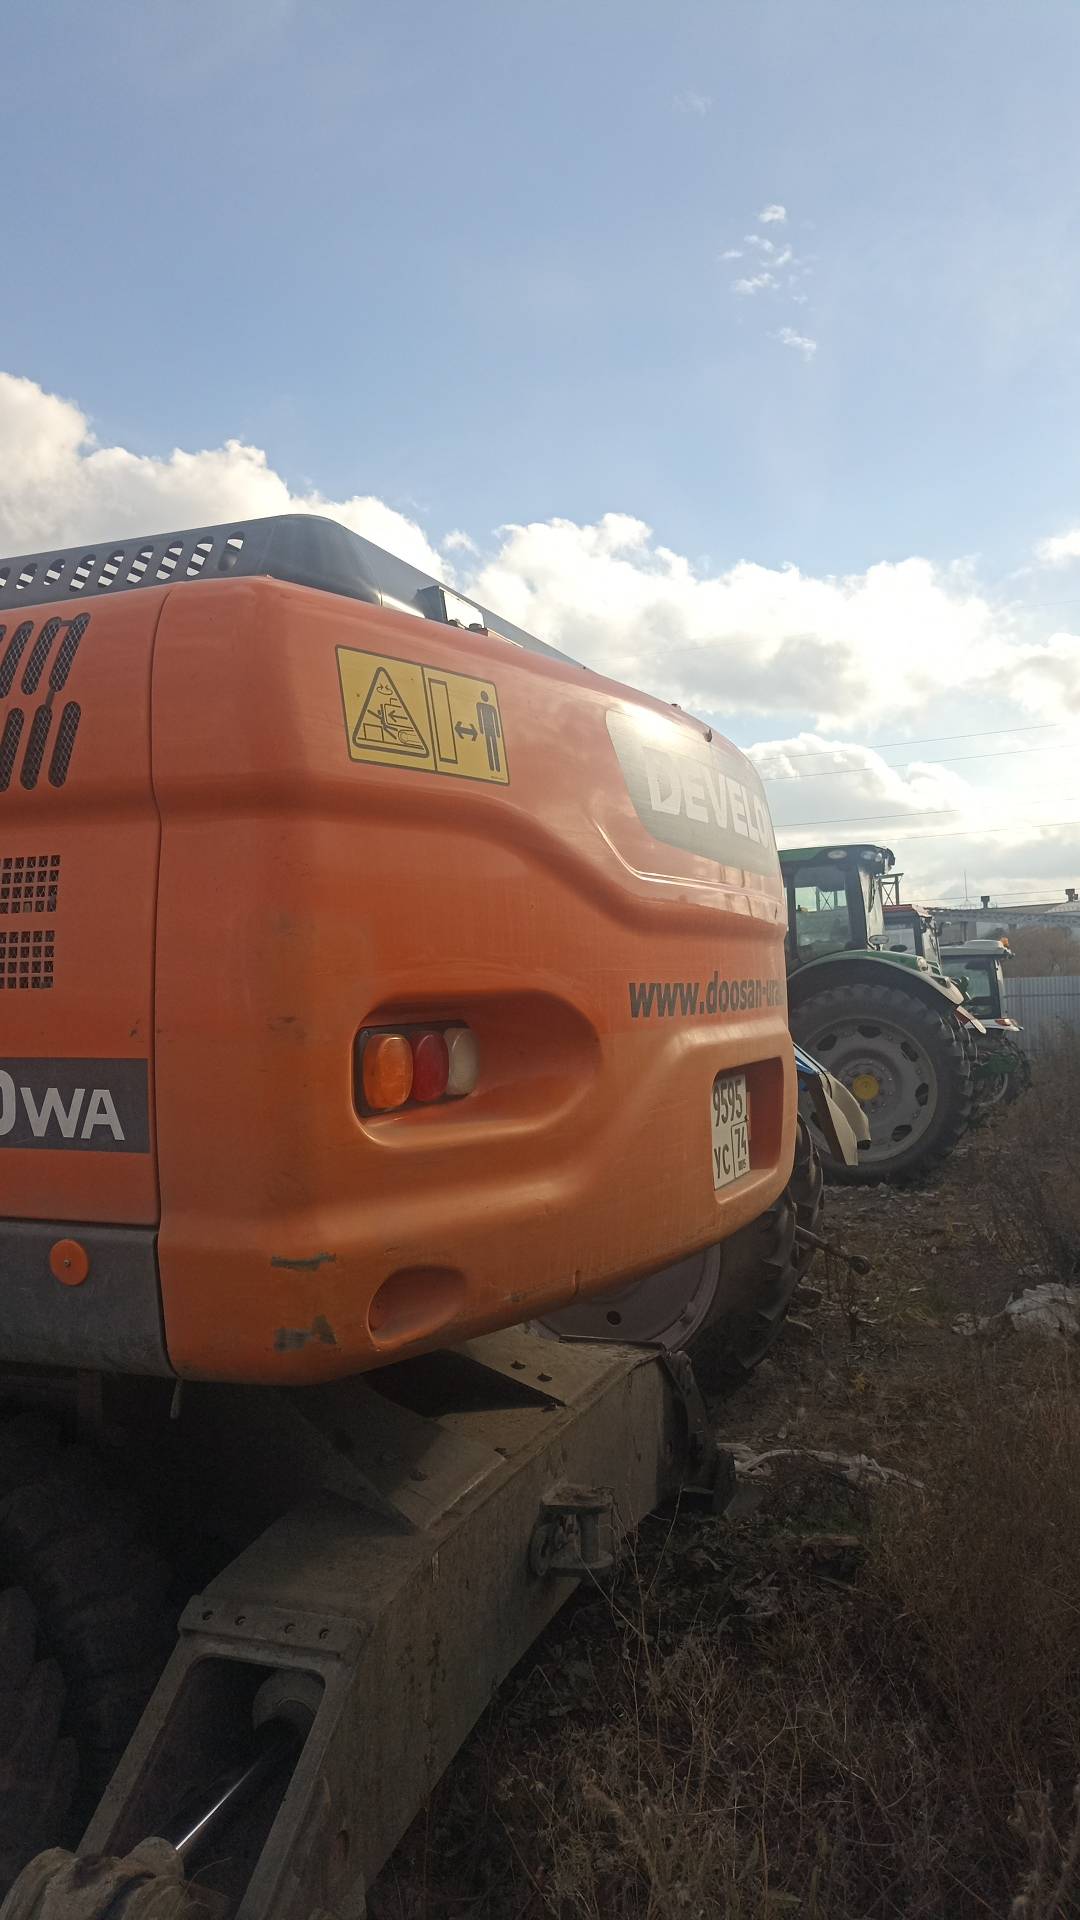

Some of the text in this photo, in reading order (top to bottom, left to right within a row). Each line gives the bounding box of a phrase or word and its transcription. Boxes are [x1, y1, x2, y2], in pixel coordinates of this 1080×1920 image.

[642, 747, 774, 855] DEVELO
[713, 1080, 743, 1127] 9595
[734, 1126, 747, 1159] 74
